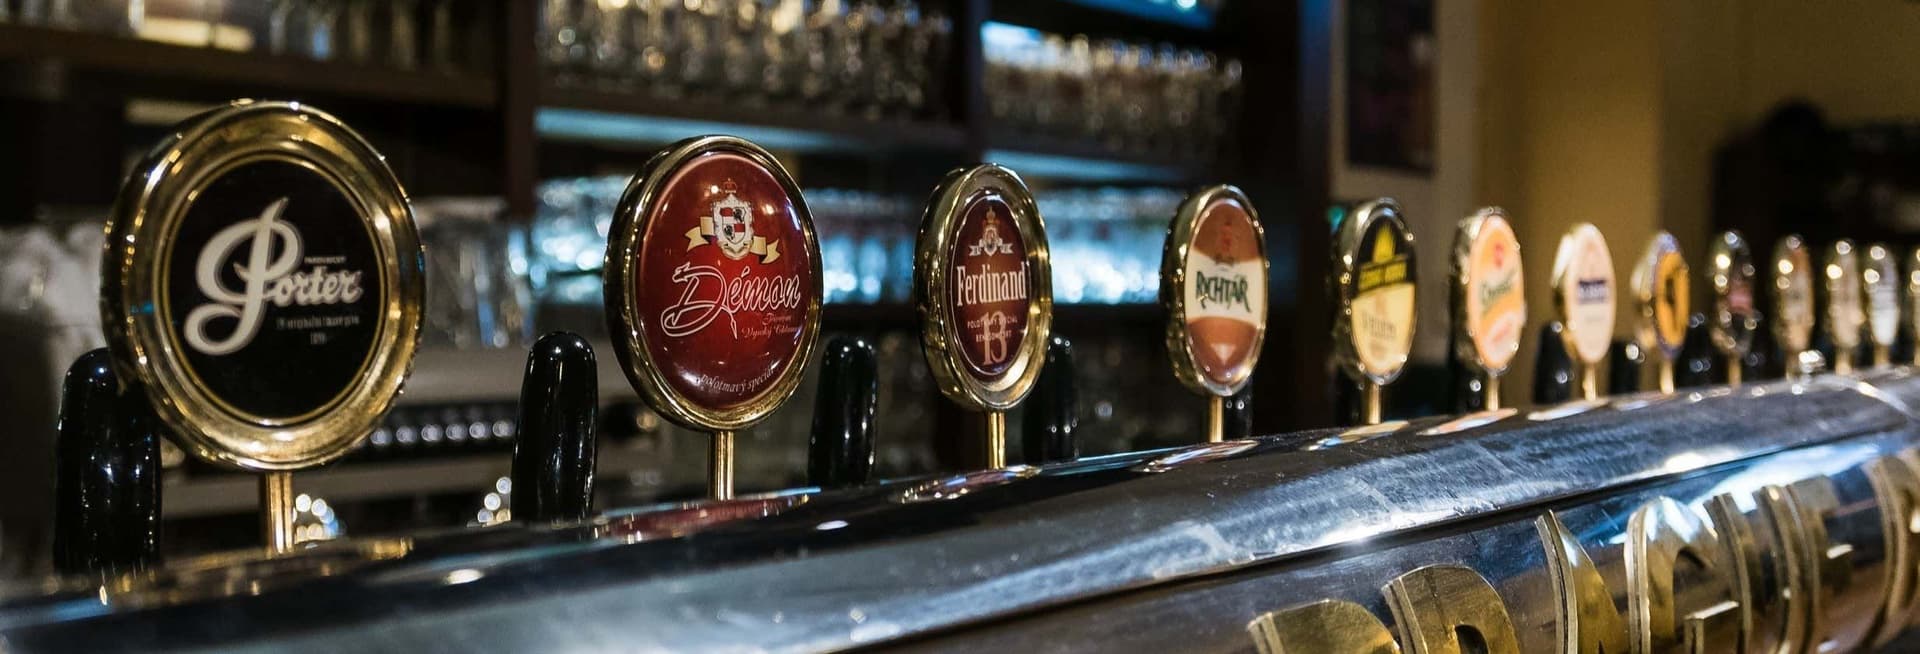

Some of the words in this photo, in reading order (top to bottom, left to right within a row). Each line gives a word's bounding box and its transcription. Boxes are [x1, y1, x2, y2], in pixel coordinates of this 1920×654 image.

[184, 197, 363, 355] Porter
[660, 262, 800, 339] Démon
[956, 261, 1027, 306] Ferdinand
[980, 311, 1007, 365] 13
